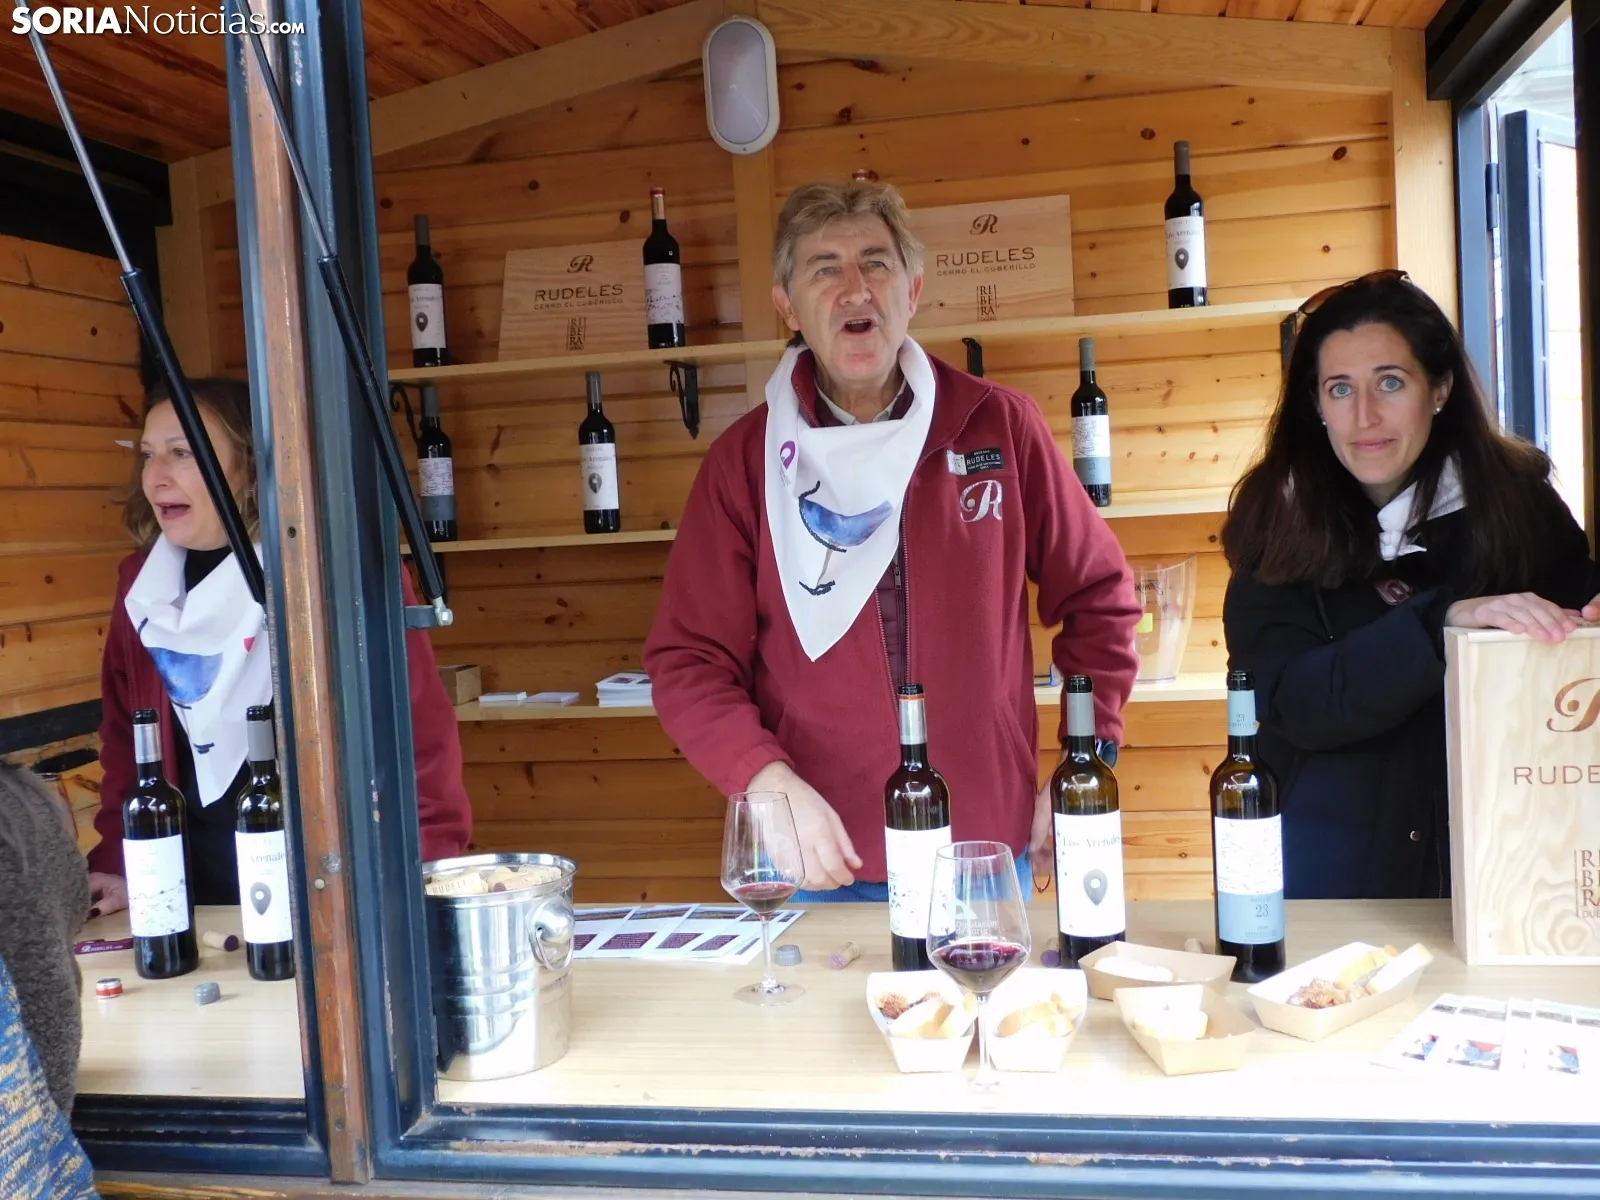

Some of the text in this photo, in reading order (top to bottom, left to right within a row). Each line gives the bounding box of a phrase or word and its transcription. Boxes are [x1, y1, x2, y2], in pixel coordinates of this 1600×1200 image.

[935, 246, 1036, 268] RUDELES
[936, 268, 968, 277] CERRO
[983, 262, 1036, 273] CUBERILLO
[534, 284, 624, 302] RUDELES
[966, 453, 1001, 466] RUDELES
[959, 480, 1003, 523] R
[1255, 903, 1269, 918] 23
